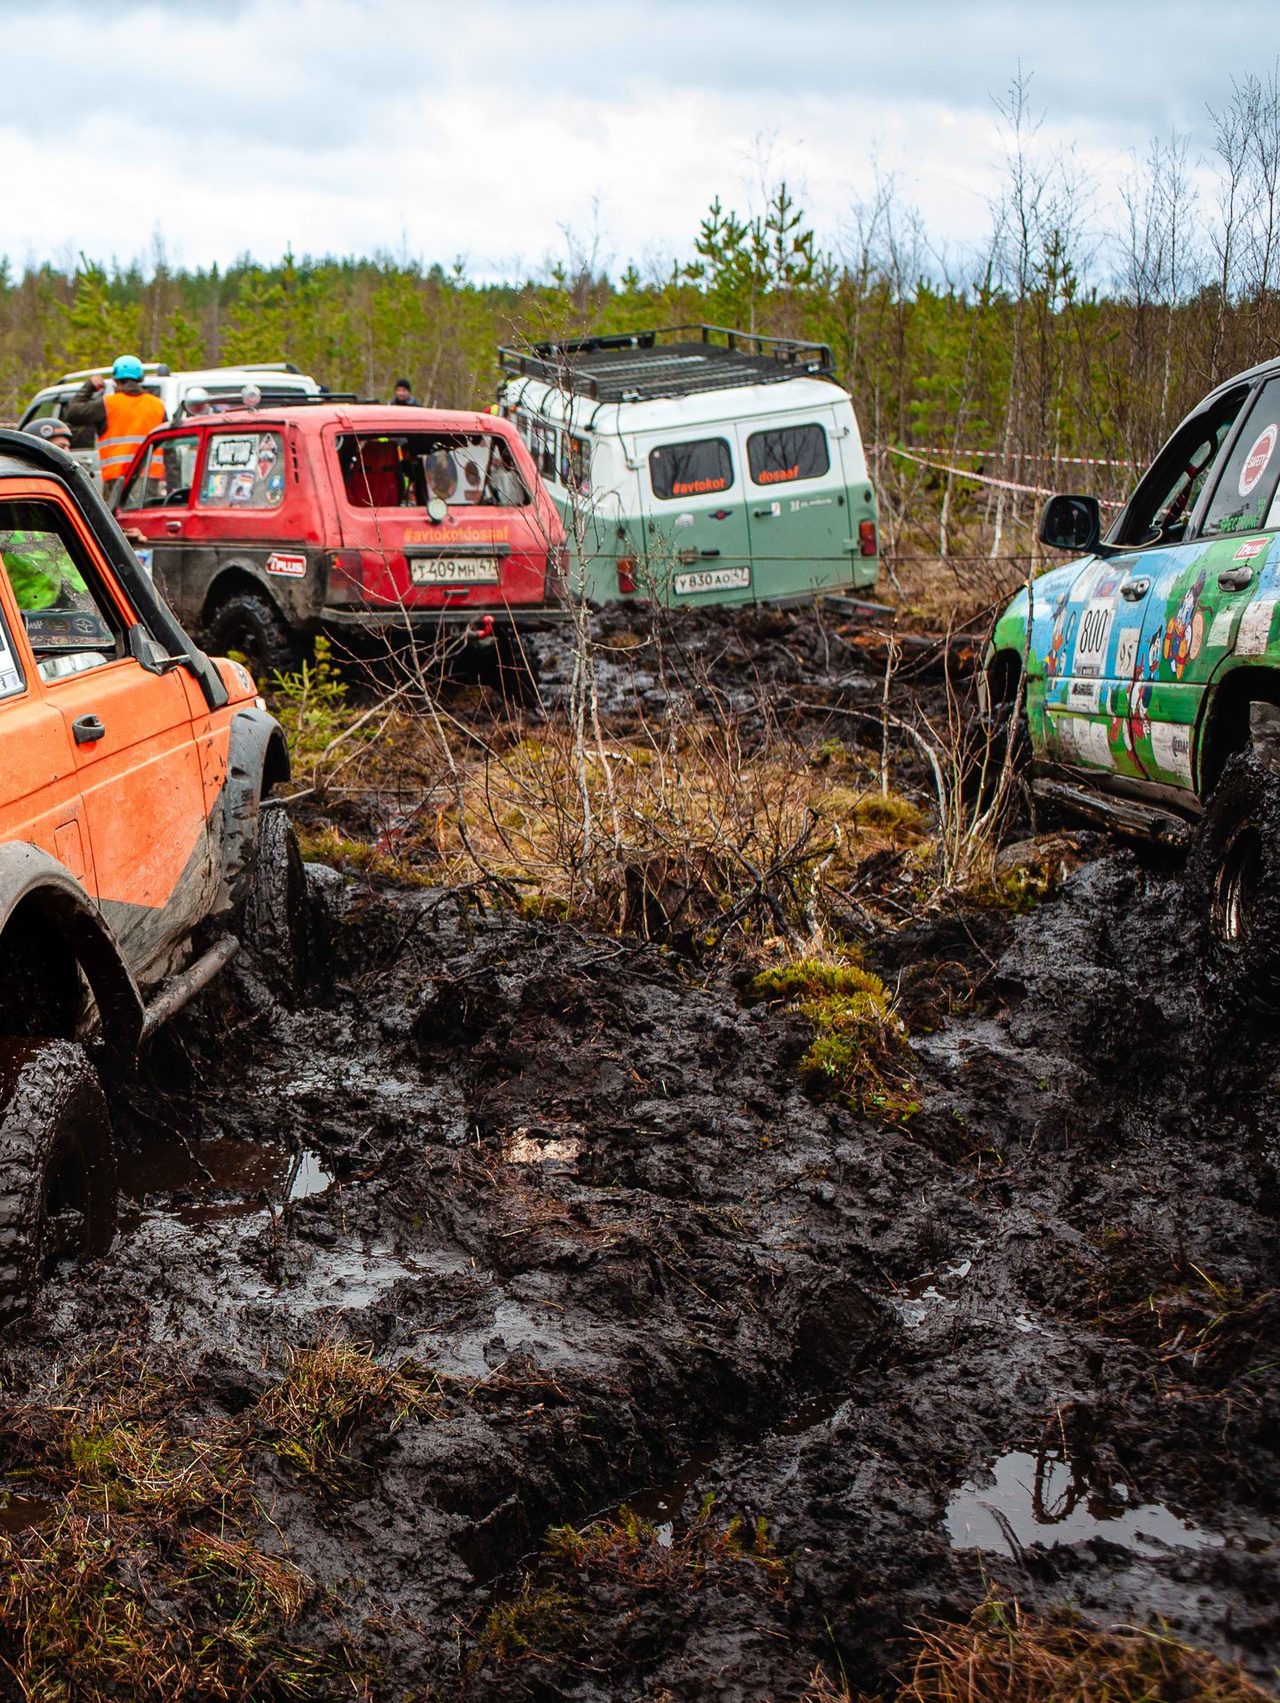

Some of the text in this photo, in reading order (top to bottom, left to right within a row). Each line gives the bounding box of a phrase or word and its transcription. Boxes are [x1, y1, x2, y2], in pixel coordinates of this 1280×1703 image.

[758, 465, 800, 484] dosaaf
[673, 477, 725, 495] #avtokot
[404, 525, 509, 543] #avtokotdosaaf
[1080, 608, 1109, 654] 800
